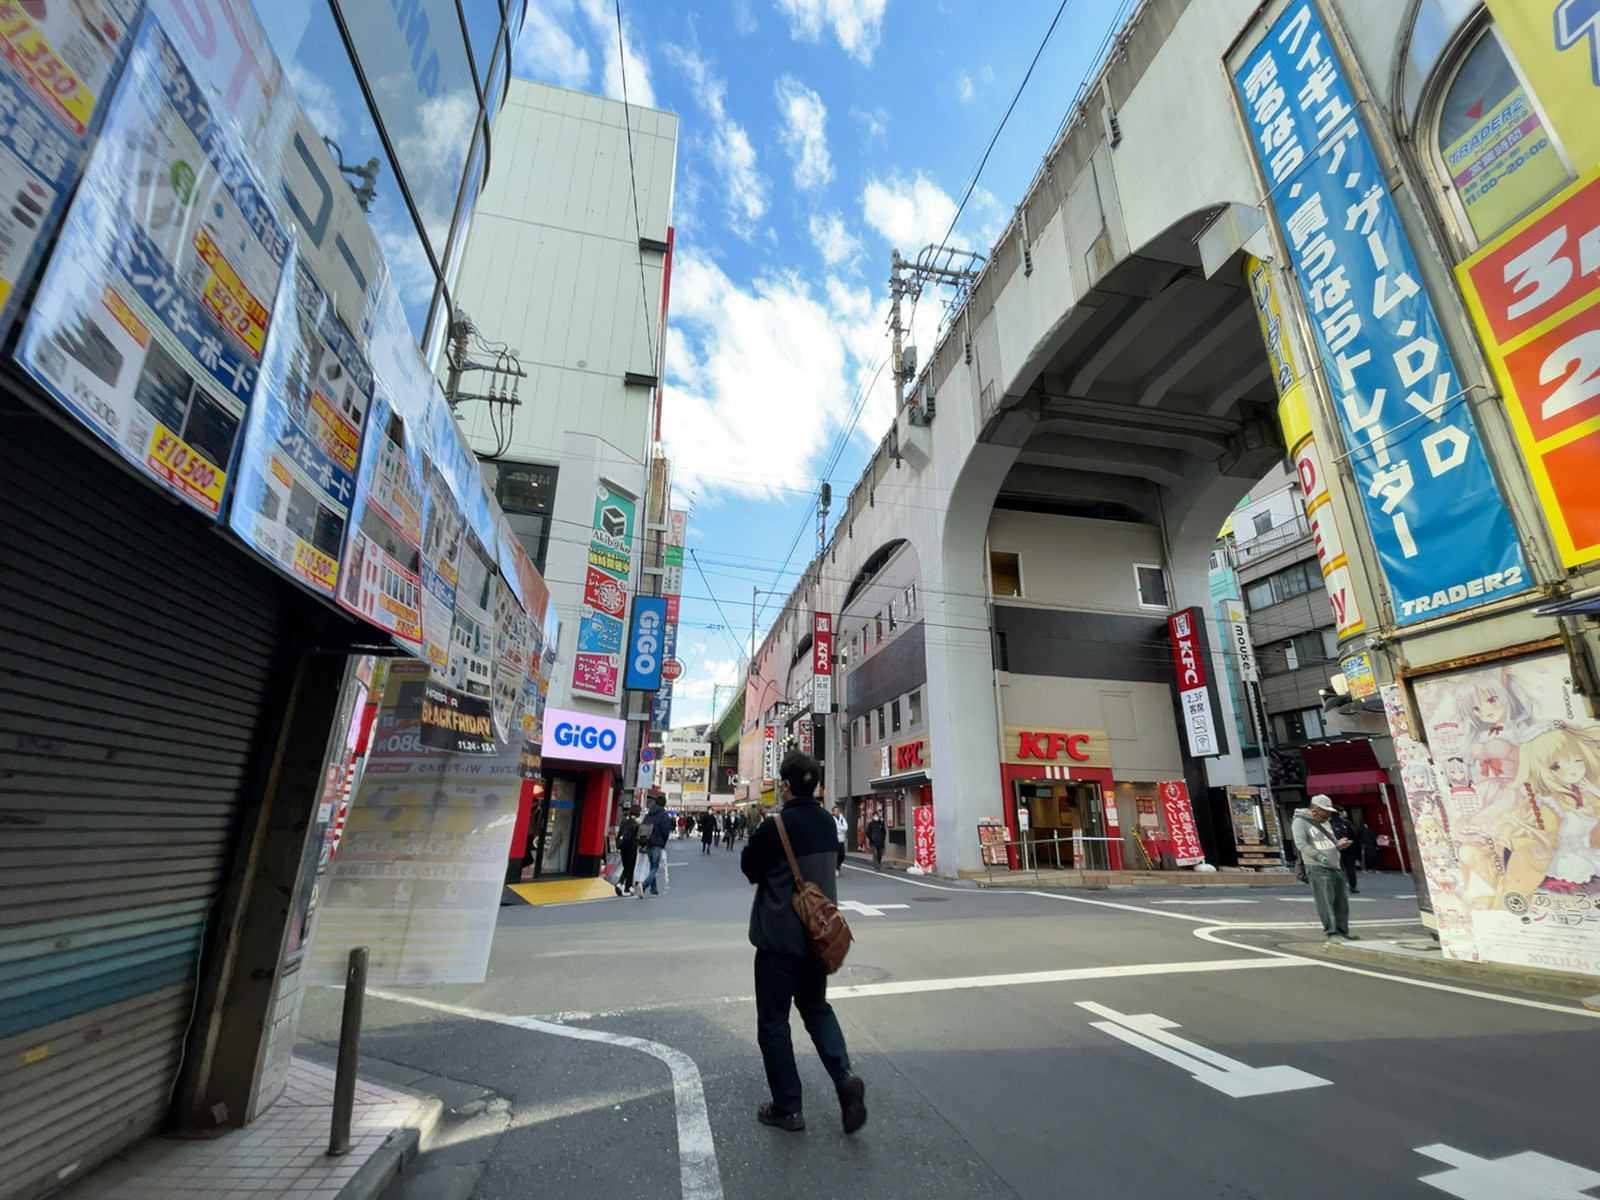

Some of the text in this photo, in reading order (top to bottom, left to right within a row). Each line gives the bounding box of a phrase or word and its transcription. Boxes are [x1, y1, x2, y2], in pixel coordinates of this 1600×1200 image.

[1448, 94, 1526, 167] TRADER2
[592, 530, 631, 554] Akib@ko
[1401, 567, 1523, 616] TRADER2
[635, 610, 660, 675] GiGO
[817, 640, 828, 670] KFC
[1234, 625, 1251, 671] mouse
[1178, 640, 1199, 685] KFC
[421, 700, 492, 737] BLACK FRIDAY
[1189, 703, 1205, 715] 客席
[553, 722, 617, 752] GiGO
[1017, 731, 1090, 761] KFC
[896, 741, 923, 770] KFC
[1534, 892, 1591, 911] あまいろ
[1528, 953, 1590, 970] 2023.11.24
